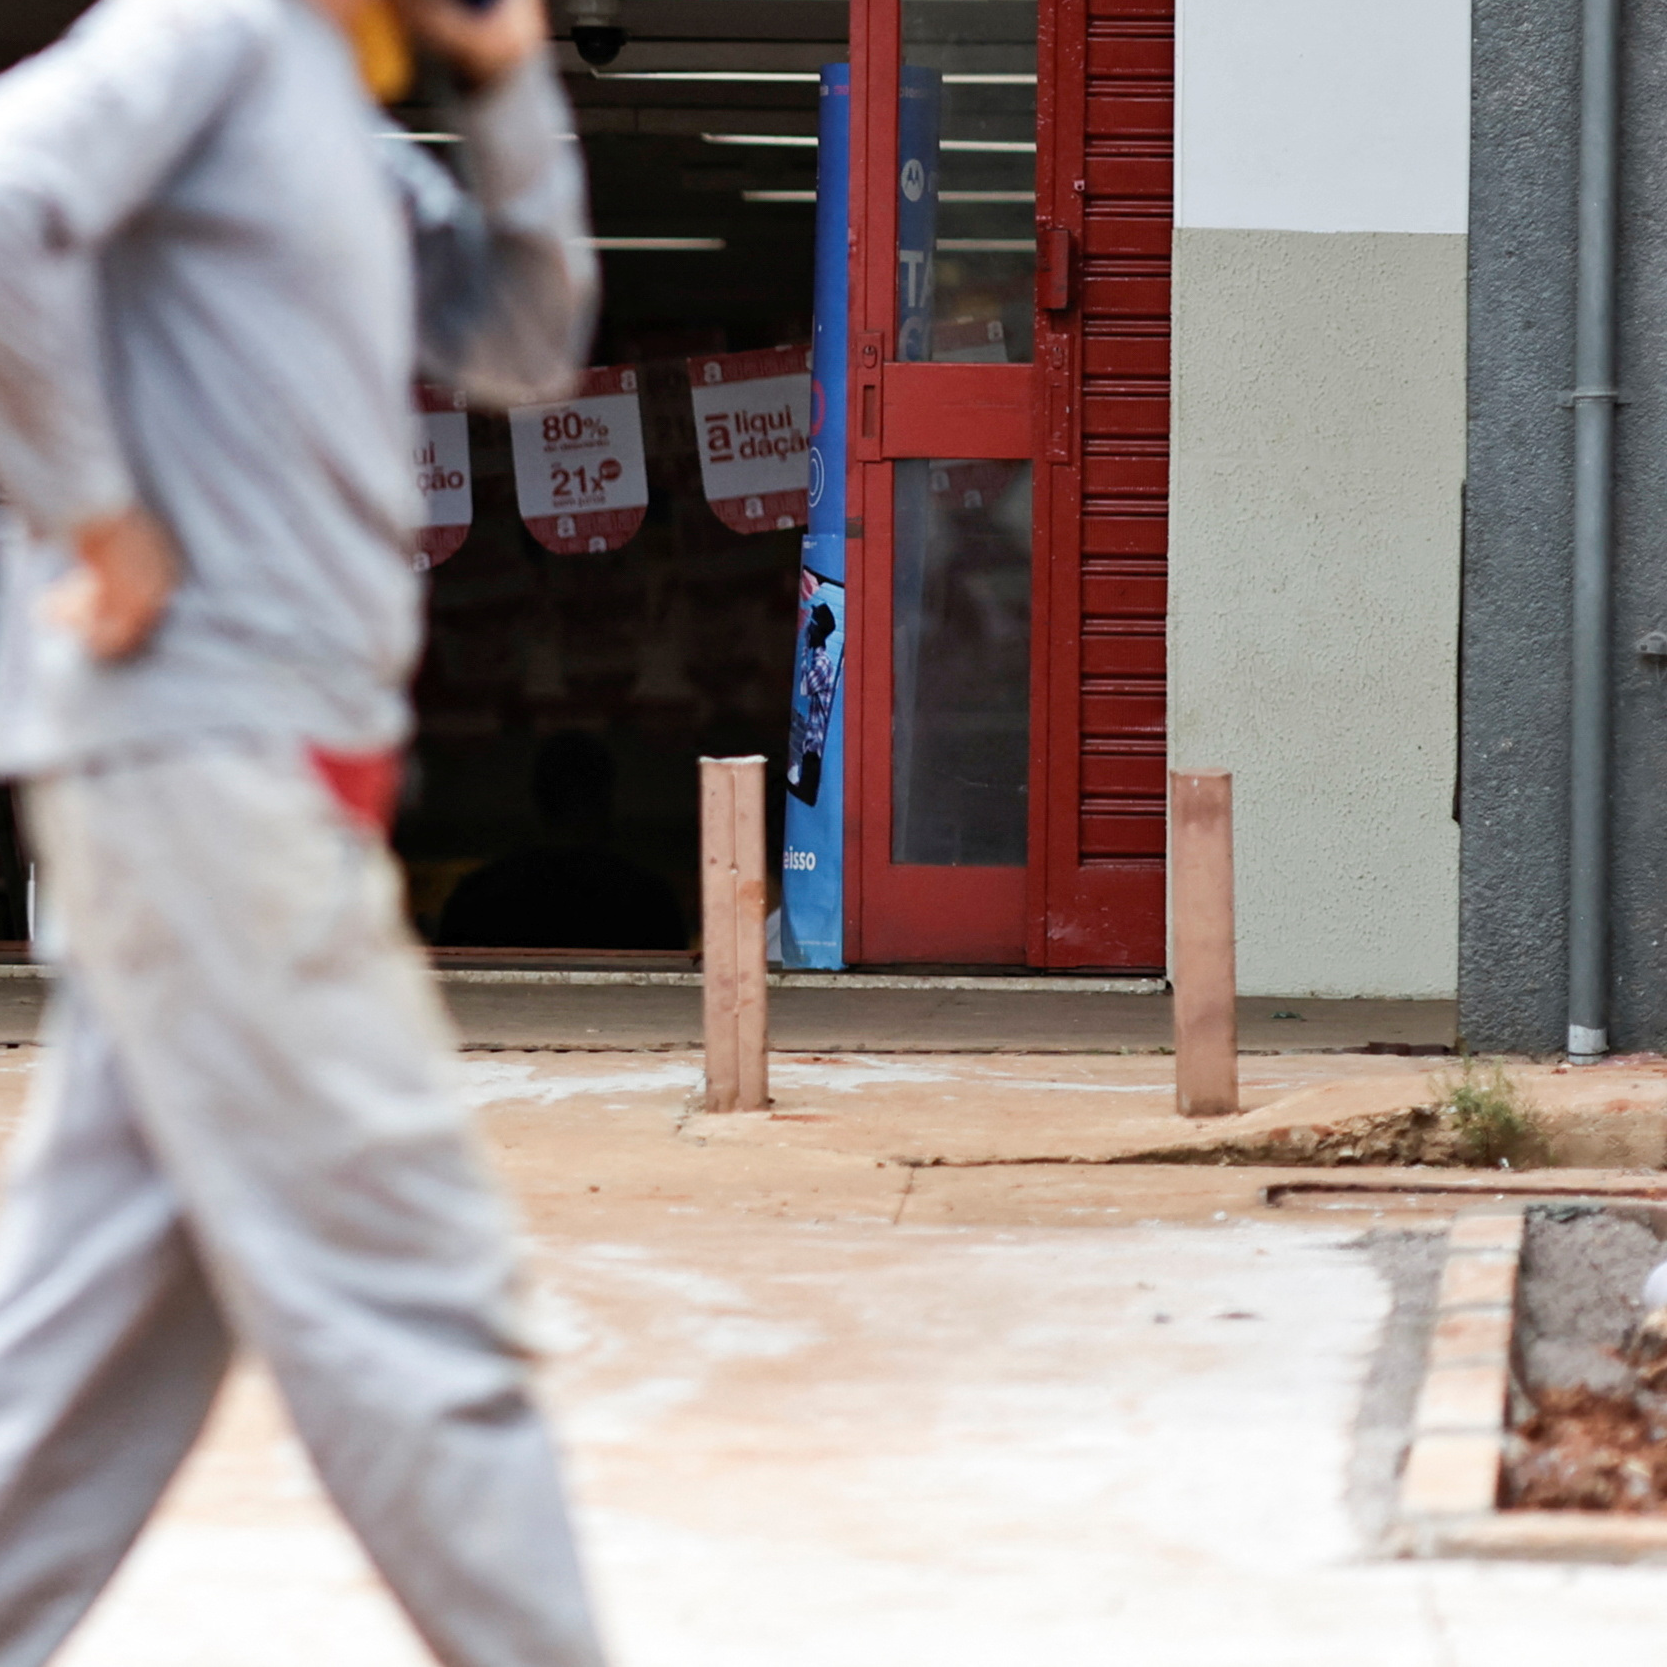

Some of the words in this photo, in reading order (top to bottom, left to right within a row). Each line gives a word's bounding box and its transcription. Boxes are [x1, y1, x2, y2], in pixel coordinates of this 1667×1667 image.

[542, 411, 610, 442] 80%
[733, 404, 793, 435] liqui
[550, 464, 605, 497] 21x
